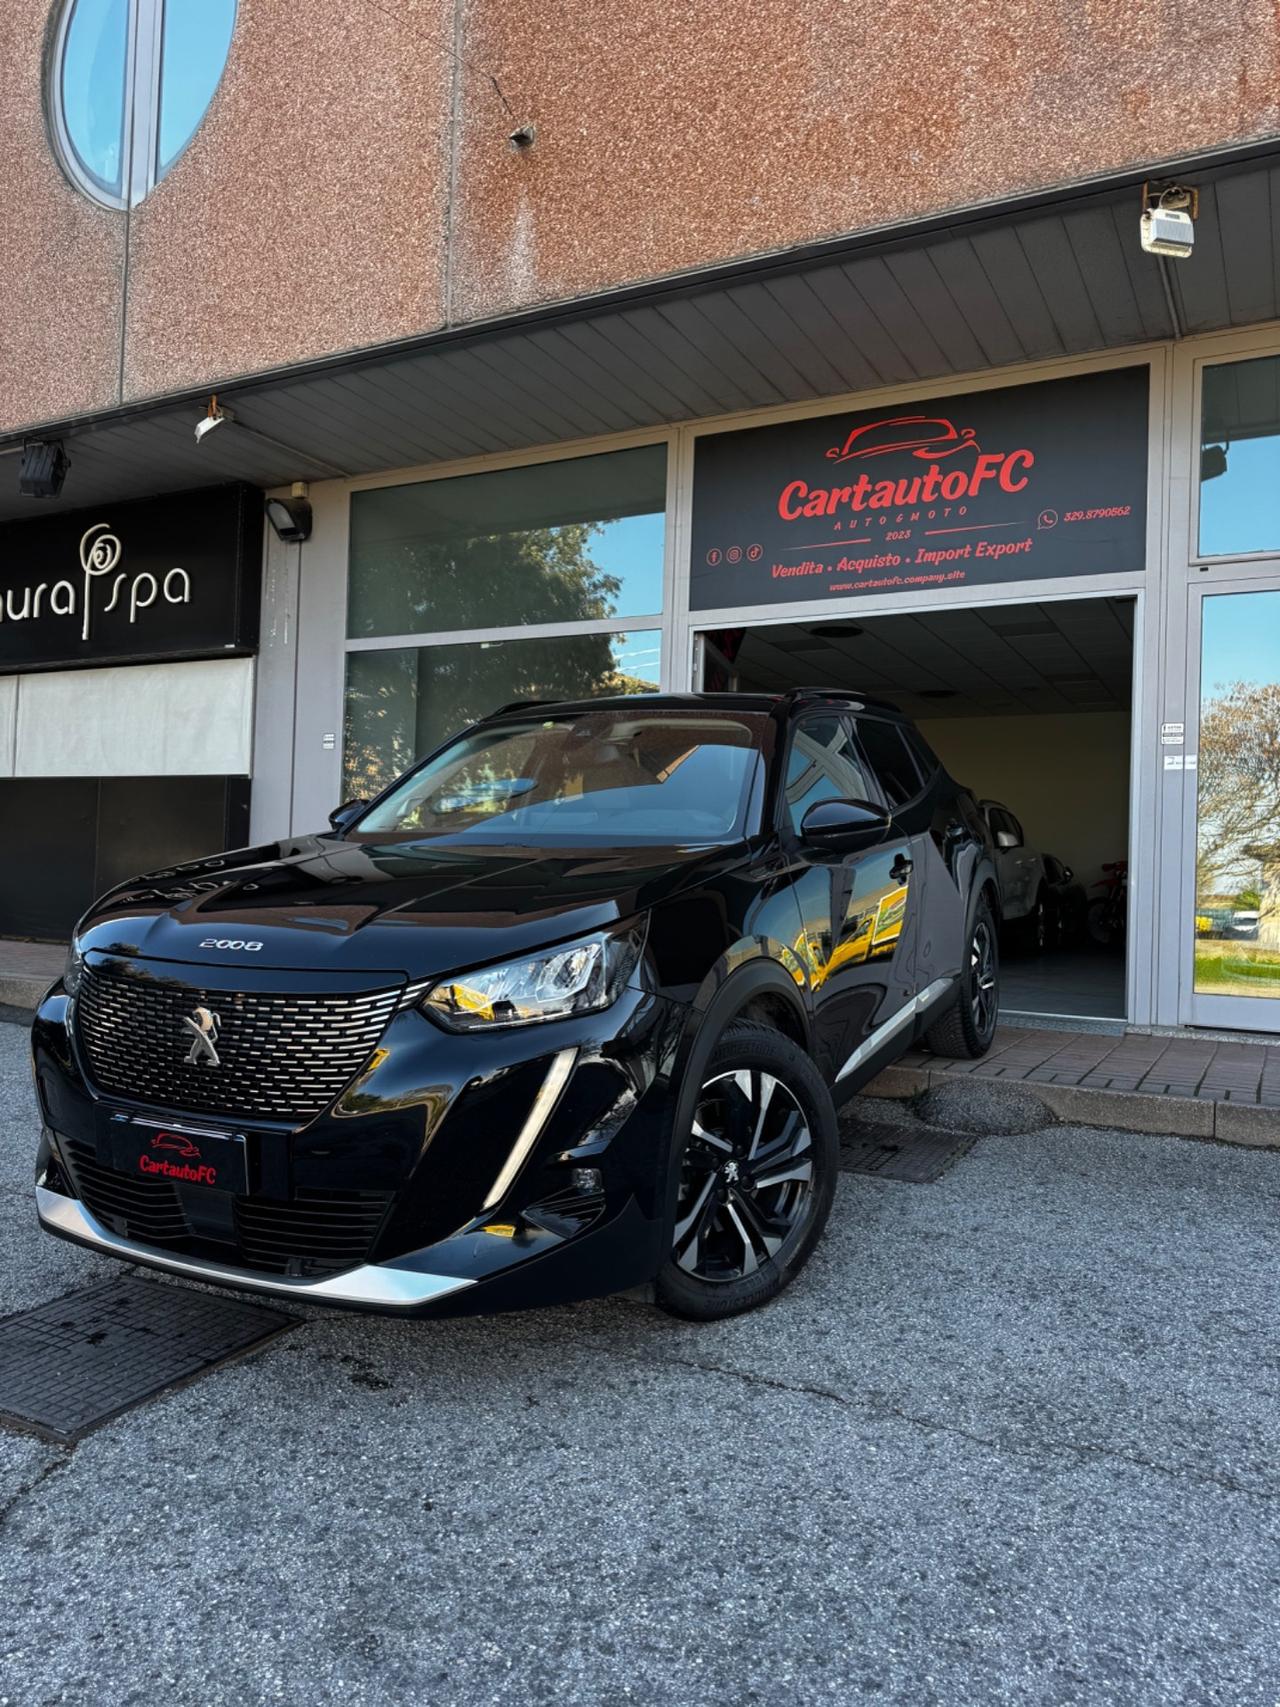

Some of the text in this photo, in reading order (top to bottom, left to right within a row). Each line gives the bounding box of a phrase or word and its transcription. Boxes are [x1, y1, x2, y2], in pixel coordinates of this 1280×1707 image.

[778, 449, 1034, 520] CartautoFC
[885, 529, 912, 541] 2023
[772, 537, 1033, 579] Vendita Acquisto Import Export
[199, 938, 264, 951] 2008
[139, 1155, 216, 1185] CartautoFC
